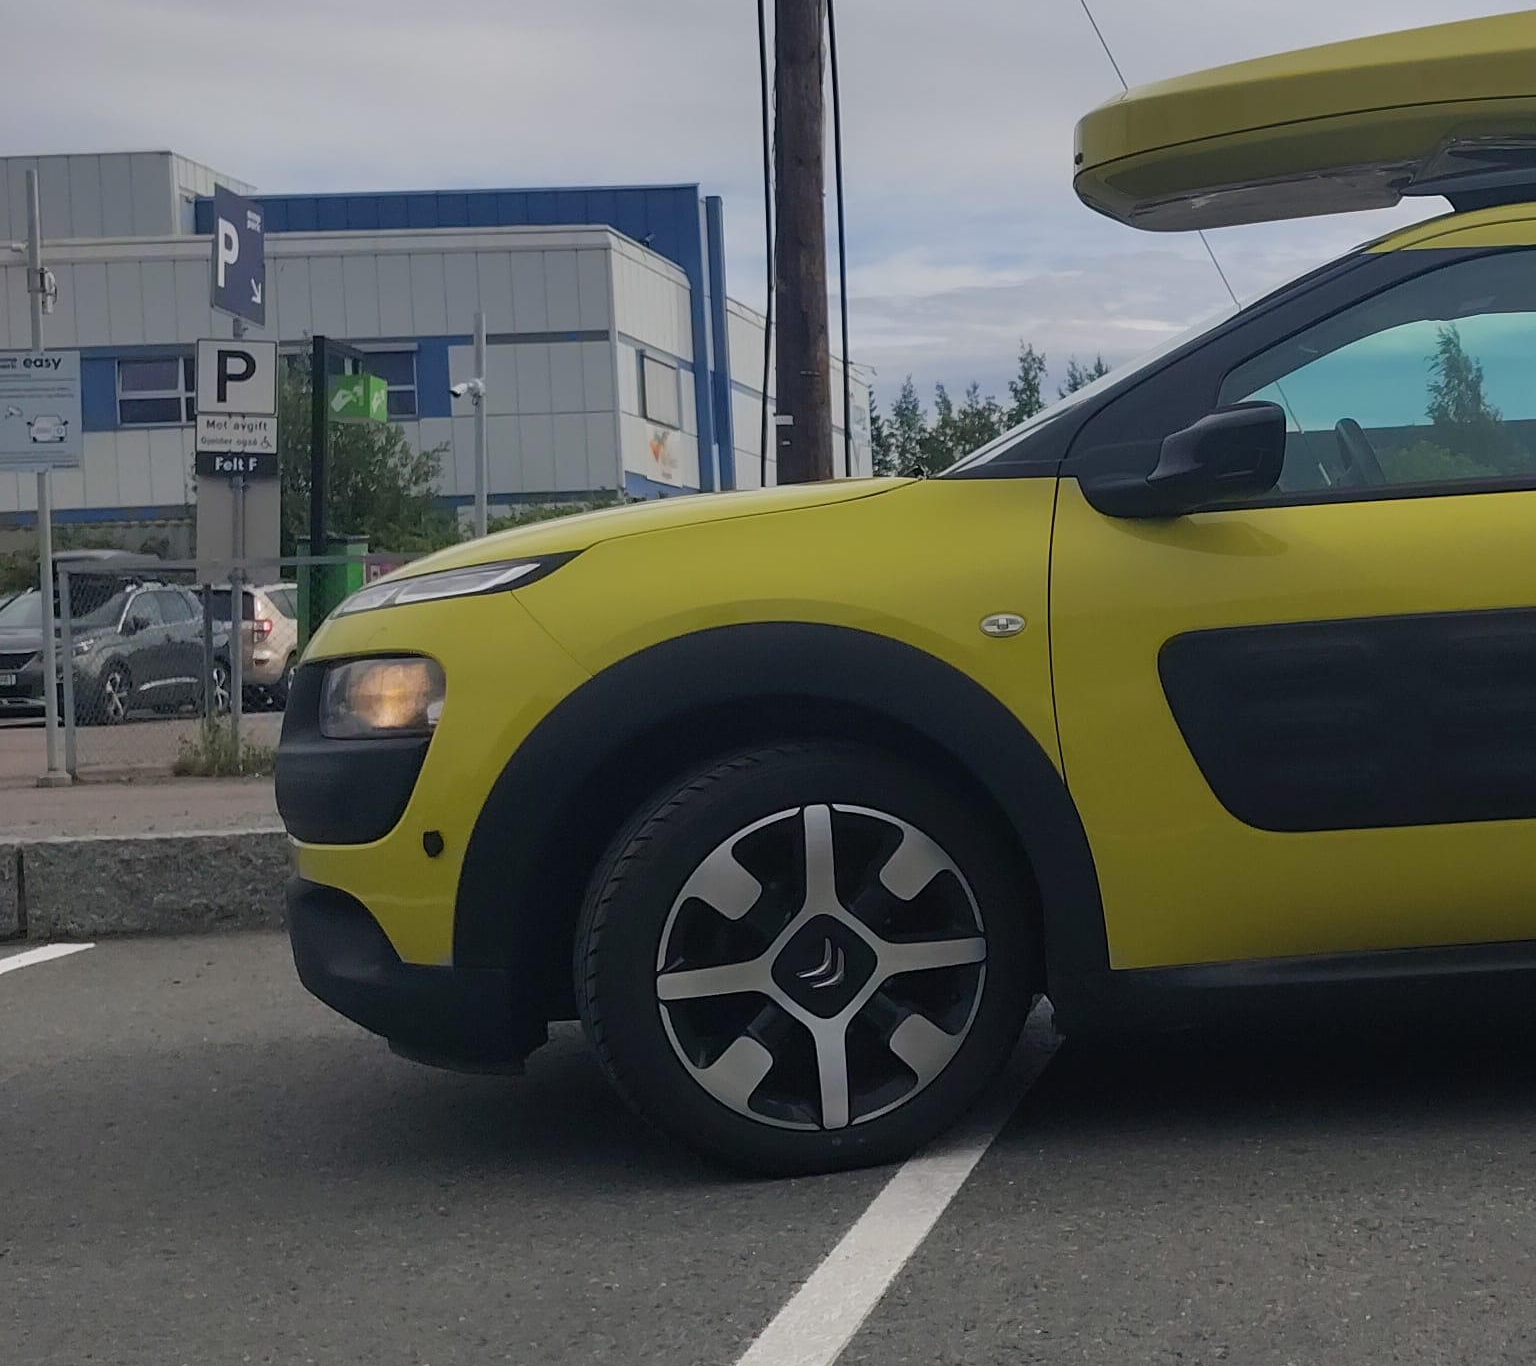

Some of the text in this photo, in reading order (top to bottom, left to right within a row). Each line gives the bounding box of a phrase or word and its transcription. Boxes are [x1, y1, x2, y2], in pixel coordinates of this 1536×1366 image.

[217, 217, 240, 288] P
[23, 358, 62, 370] easy
[217, 350, 256, 403] P
[206, 419, 267, 433] Mot avgift
[215, 456, 258, 471] Felt F
